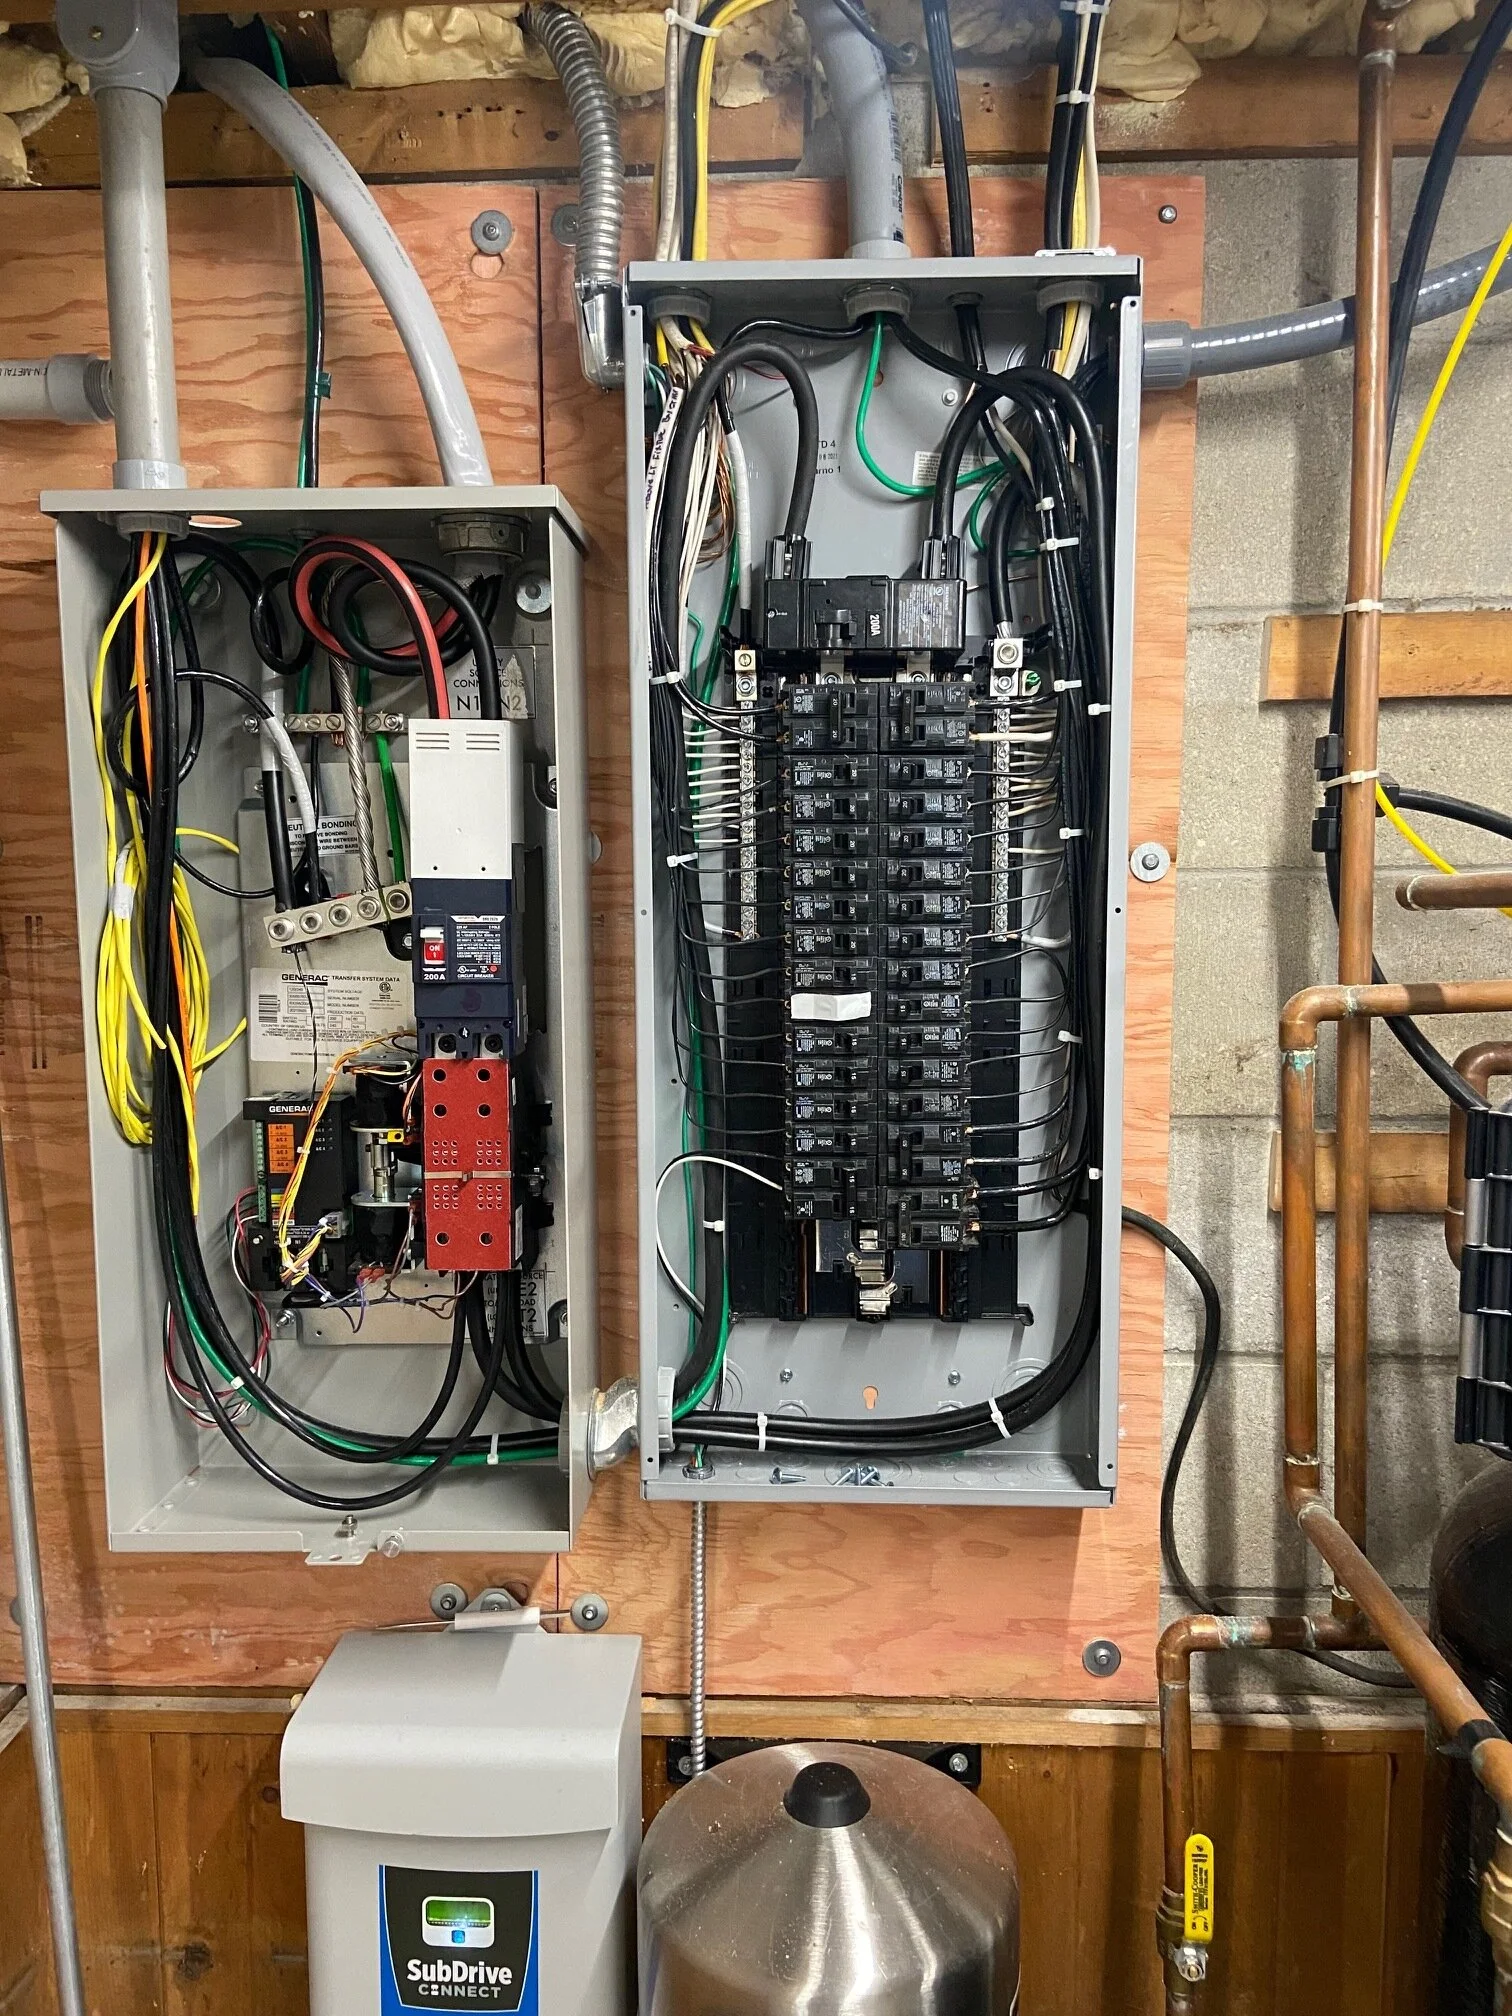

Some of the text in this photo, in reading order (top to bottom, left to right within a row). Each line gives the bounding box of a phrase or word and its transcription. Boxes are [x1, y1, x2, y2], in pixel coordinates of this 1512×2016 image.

[870, 614, 880, 636] 200A
[832, 698, 838, 706] 20
[832, 730, 838, 738] 20
[852, 769, 858, 777] 20
[850, 840, 856, 848] 20
[850, 873, 856, 882] 20
[850, 941, 856, 949] 20
[407, 1959, 512, 1985] SubDrive
